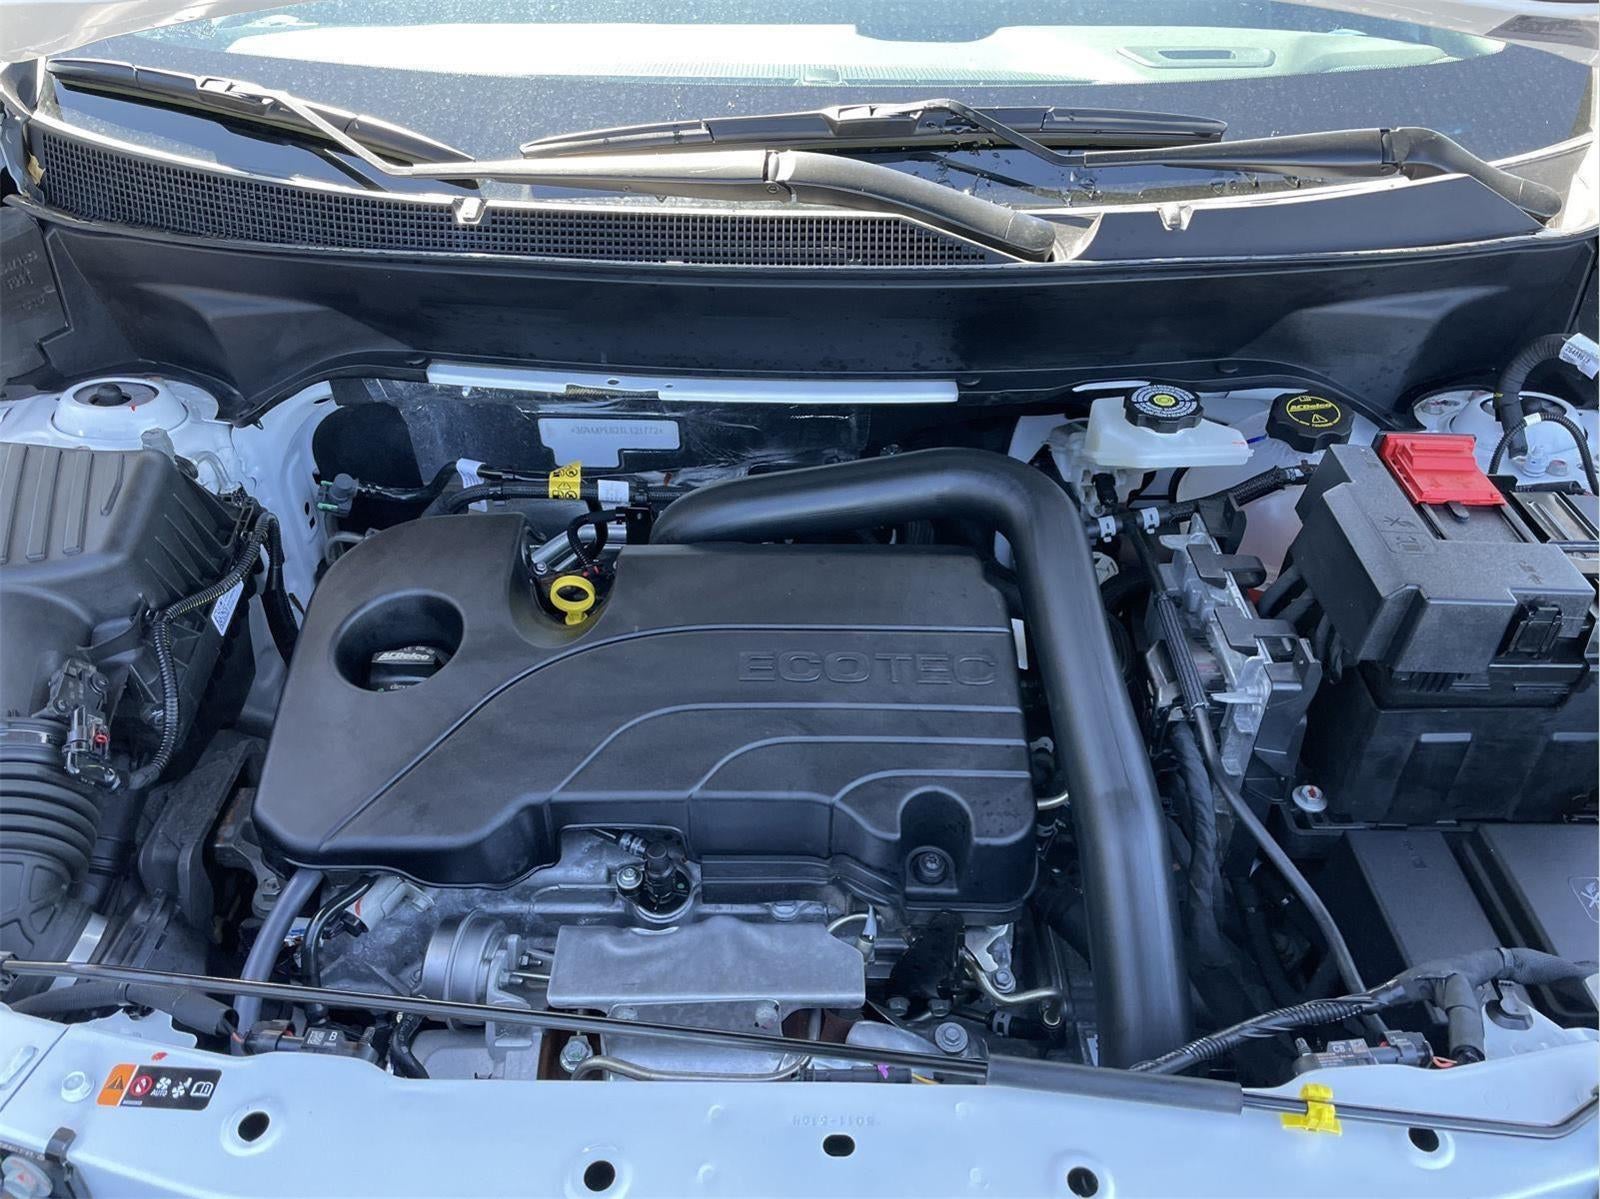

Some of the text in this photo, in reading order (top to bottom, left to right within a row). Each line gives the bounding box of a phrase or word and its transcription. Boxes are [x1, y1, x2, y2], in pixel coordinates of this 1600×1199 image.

[738, 651, 996, 686] ECOTEC
[328, 1031, 338, 1041] B
[150, 1089, 168, 1097] AUTO
